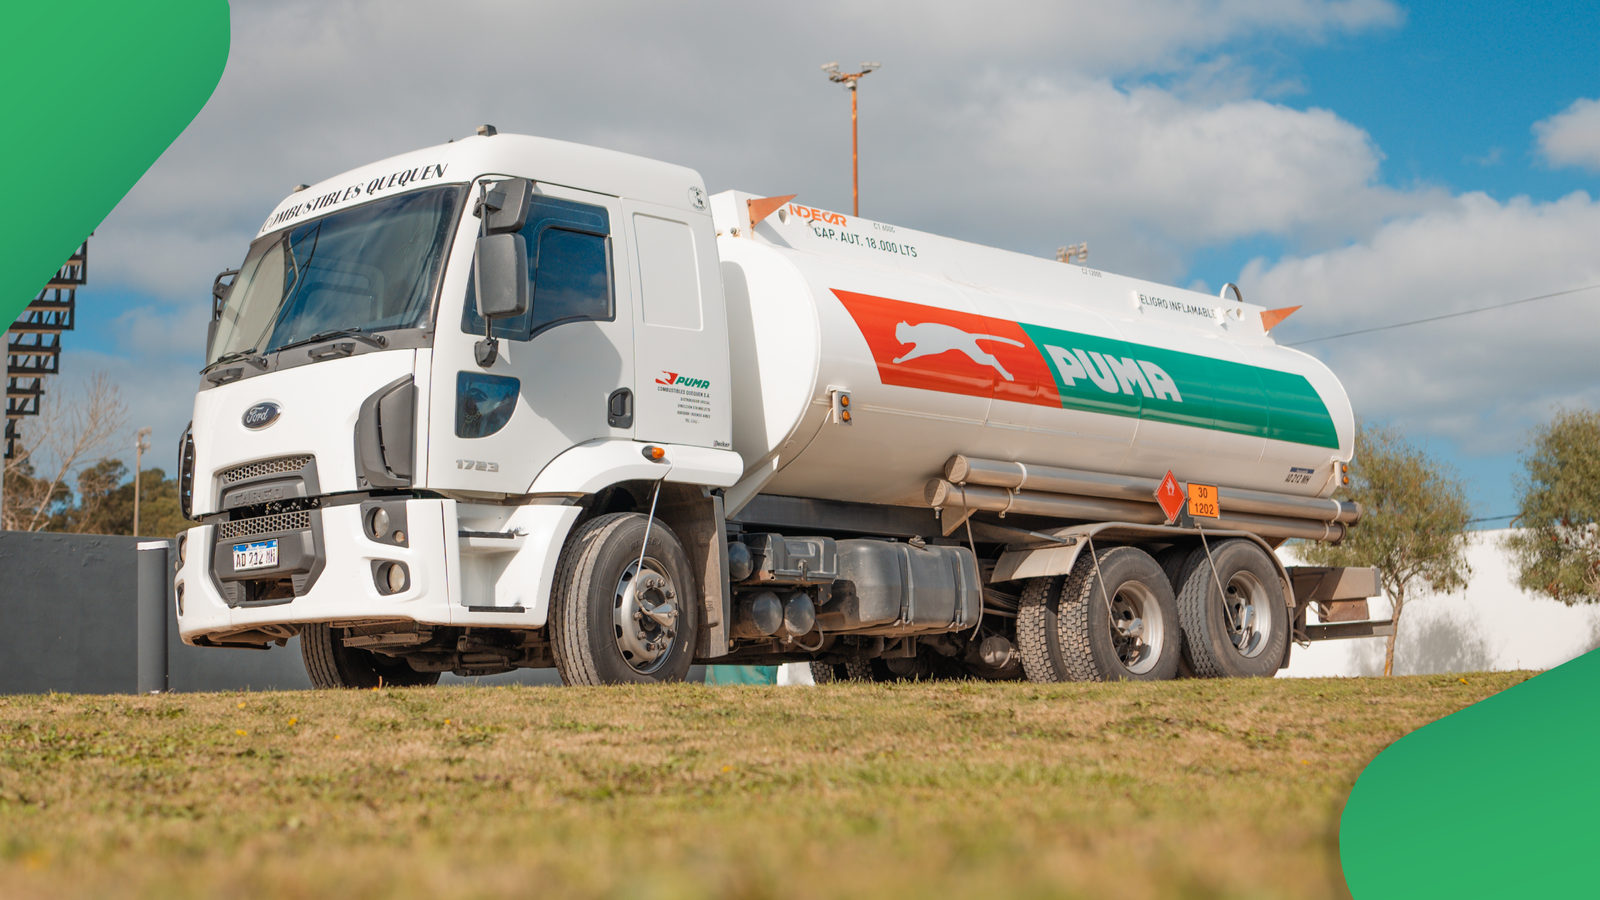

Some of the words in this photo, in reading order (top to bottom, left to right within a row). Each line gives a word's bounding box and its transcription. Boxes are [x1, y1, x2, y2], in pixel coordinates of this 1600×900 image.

[262, 182, 364, 233] COMBUSTIBLES
[366, 163, 449, 195] QUEQUEN
[814, 227, 838, 240] CAP.
[840, 231, 864, 246] AUT.
[865, 236, 898, 254] 18.000
[899, 244, 918, 258] LTS
[1138, 293, 1168, 310] ELIGRO
[1043, 343, 1183, 403] PUMA
[676, 377, 710, 389] PUMA
[657, 386, 685, 395] COMBUSTIBLES
[686, 389, 703, 397] QUEQUEN
[246, 406, 270, 424] Ford
[456, 458, 499, 473] 1723
[1198, 488, 1208, 498] 30
[1195, 503, 1214, 515] 1202
[236, 553, 246, 568] AD
[249, 552, 263, 565] 212
